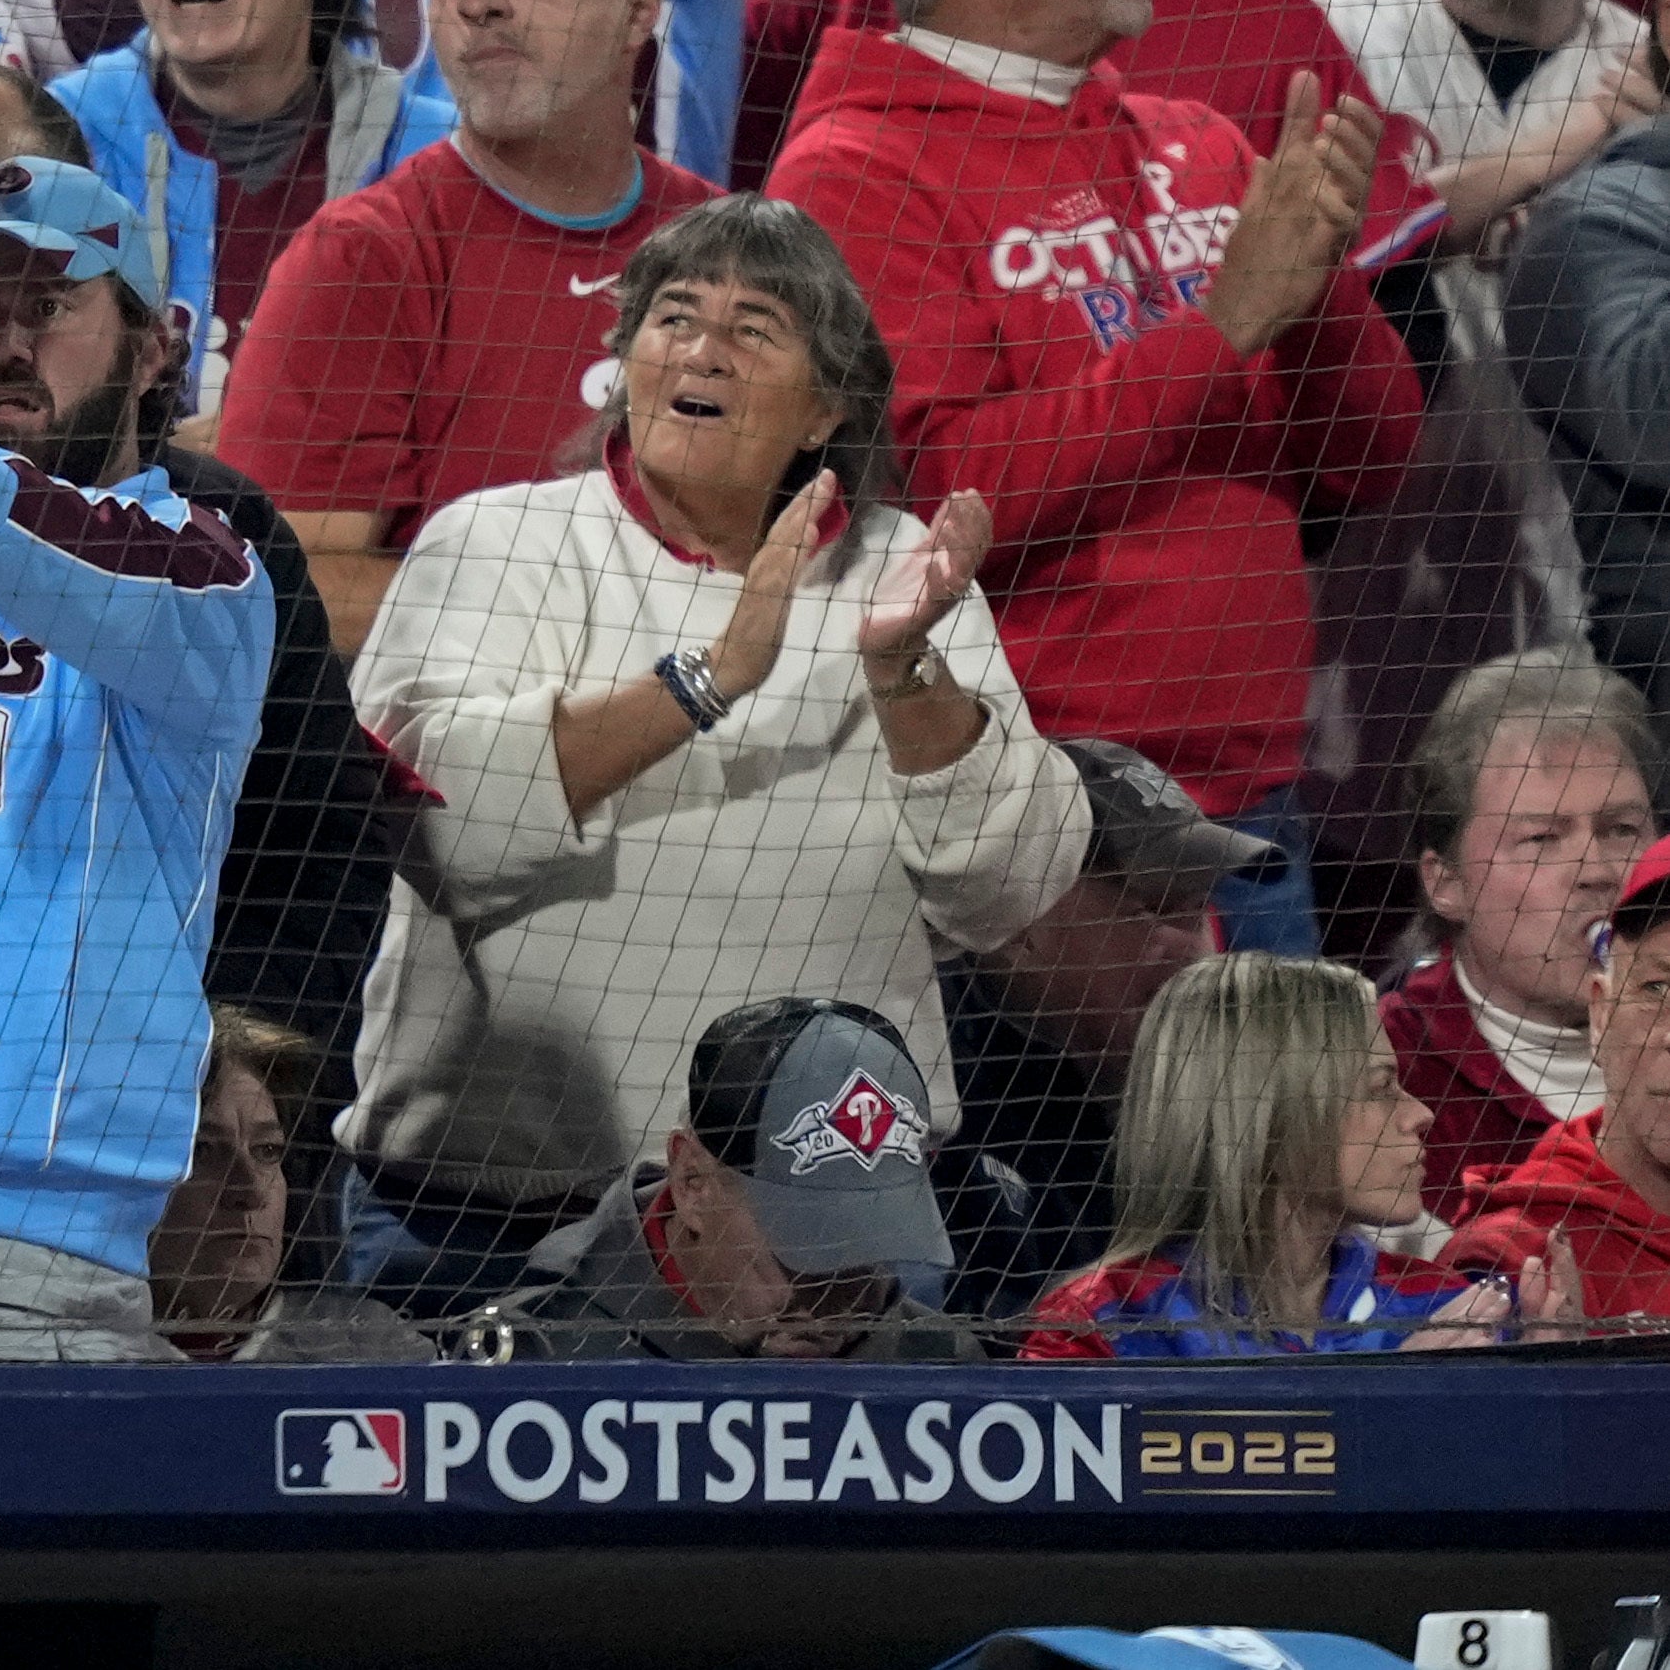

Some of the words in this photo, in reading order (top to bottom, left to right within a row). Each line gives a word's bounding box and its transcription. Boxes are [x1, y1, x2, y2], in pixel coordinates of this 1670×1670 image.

[423, 1400, 1123, 1504] POSTSEASON
[1139, 1431, 1337, 1476] 2022
[1459, 1619, 1489, 1669] 8
